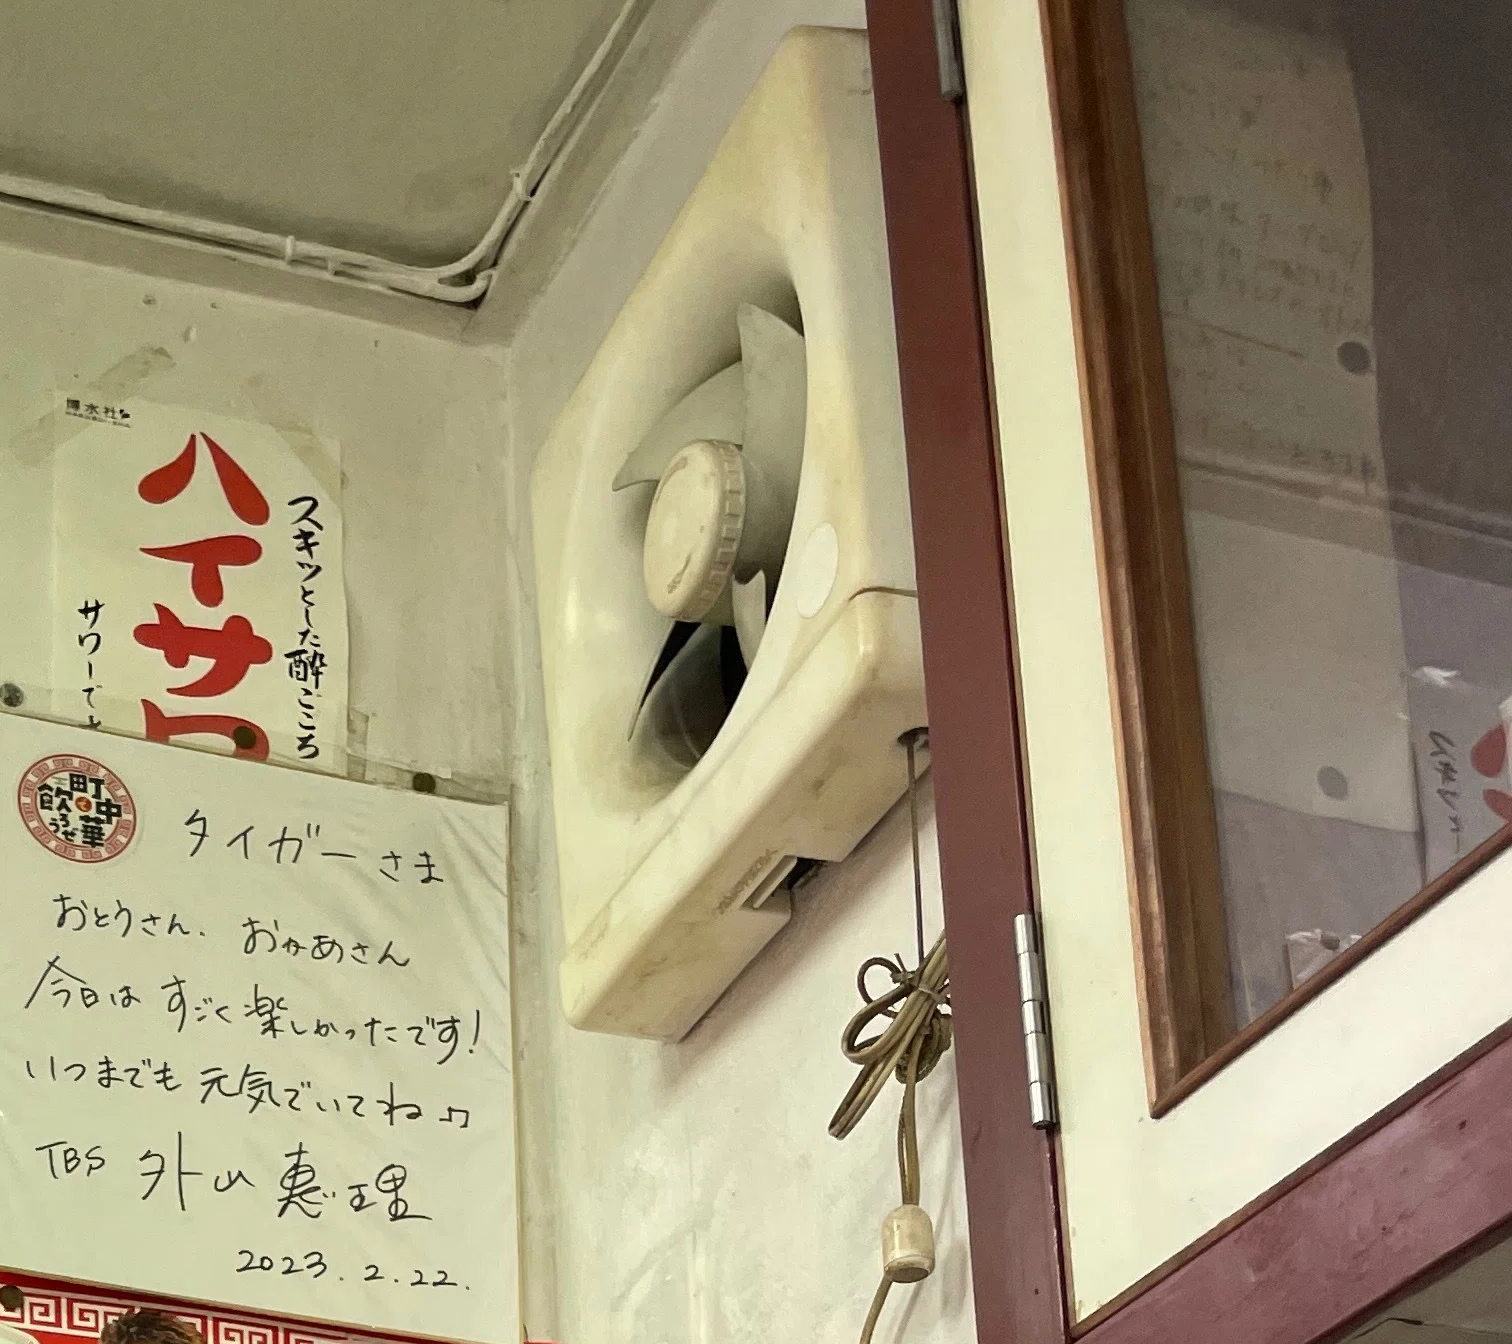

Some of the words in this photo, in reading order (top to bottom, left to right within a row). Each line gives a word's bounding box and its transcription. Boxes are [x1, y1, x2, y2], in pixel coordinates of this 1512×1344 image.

[184, 809, 444, 885] タイガーさま
[35, 1140, 106, 1181] TBS
